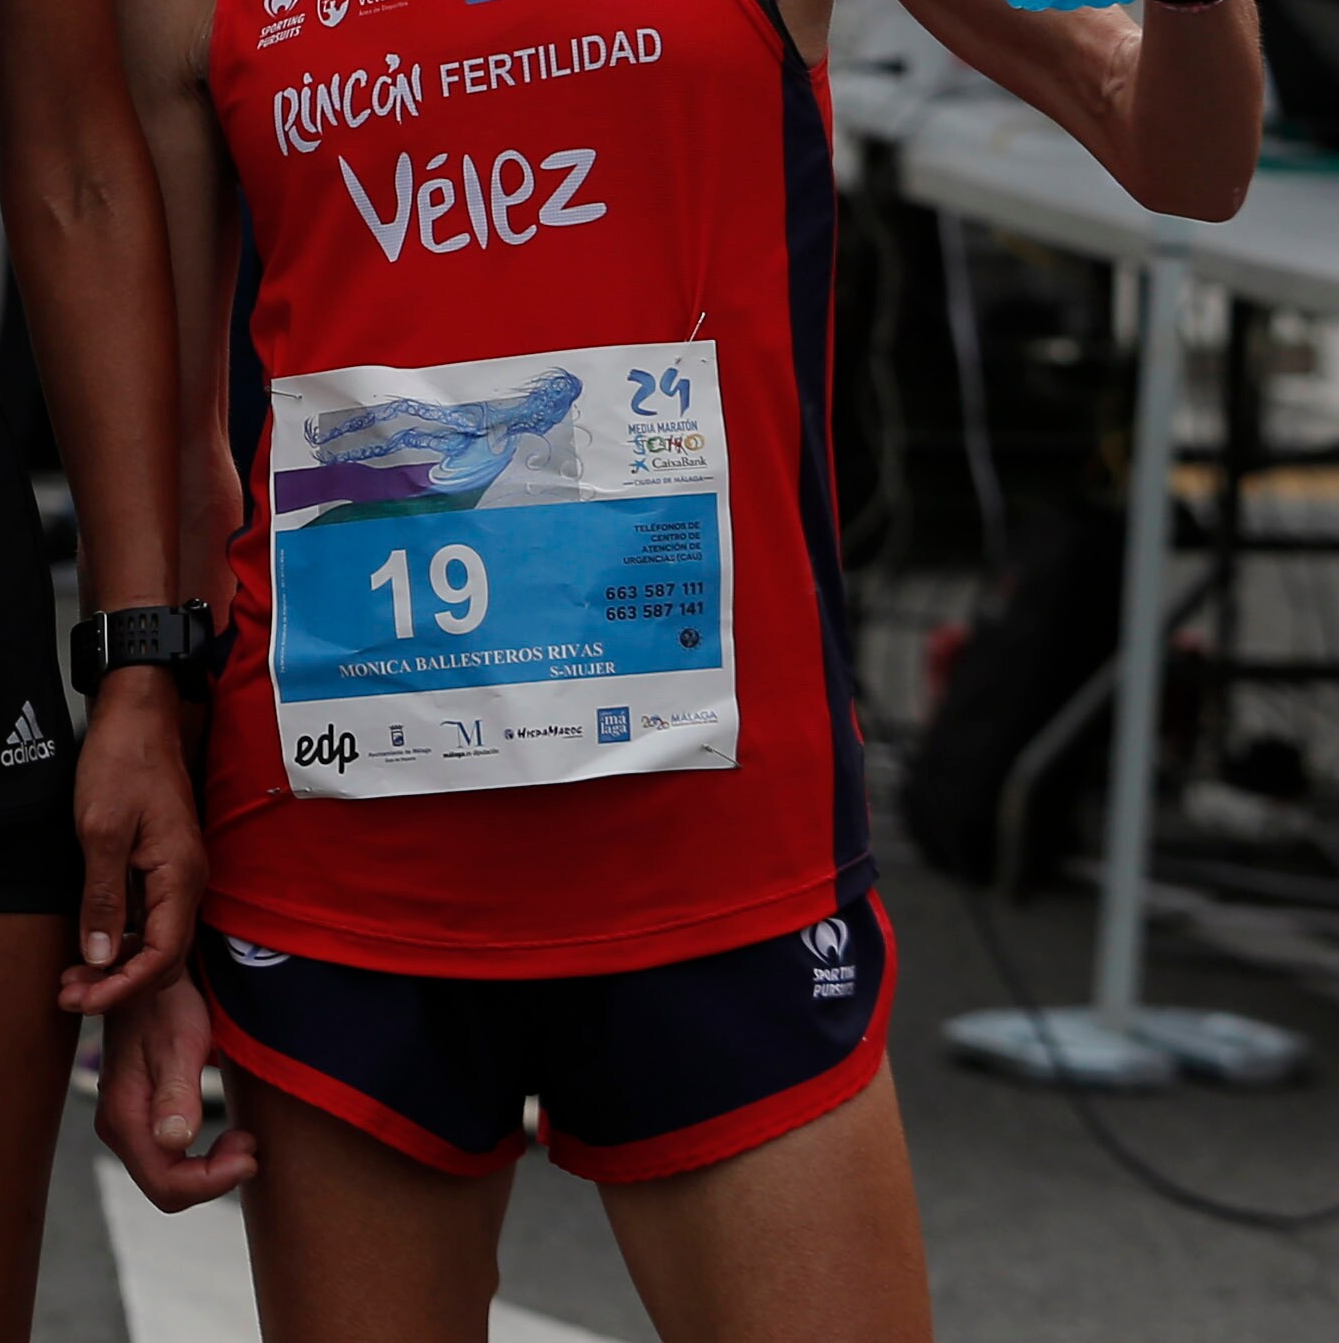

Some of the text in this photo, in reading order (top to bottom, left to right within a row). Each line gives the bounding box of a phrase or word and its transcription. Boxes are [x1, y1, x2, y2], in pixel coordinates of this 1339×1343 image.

[259, 12, 306, 38] SPORTING
[257, 25, 302, 50] PURSUITS
[440, 28, 662, 97] FERTILIDAD
[628, 419, 698, 435] MEDIA MARATÓN
[652, 456, 707, 469] CaixaBank
[688, 521, 700, 530] DE
[651, 532, 700, 542] CENTRO DE
[369, 543, 490, 640] 19
[606, 581, 704, 601] 663 587 111
[606, 601, 704, 621] 663 587 141
[339, 642, 603, 679] MONICA BALLESTEROS RIVAS
[550, 662, 617, 678] S-MUJER
[671, 710, 718, 723] MÁLAGA
[0, 739, 56, 767] adidas
[294, 723, 359, 774] edp
